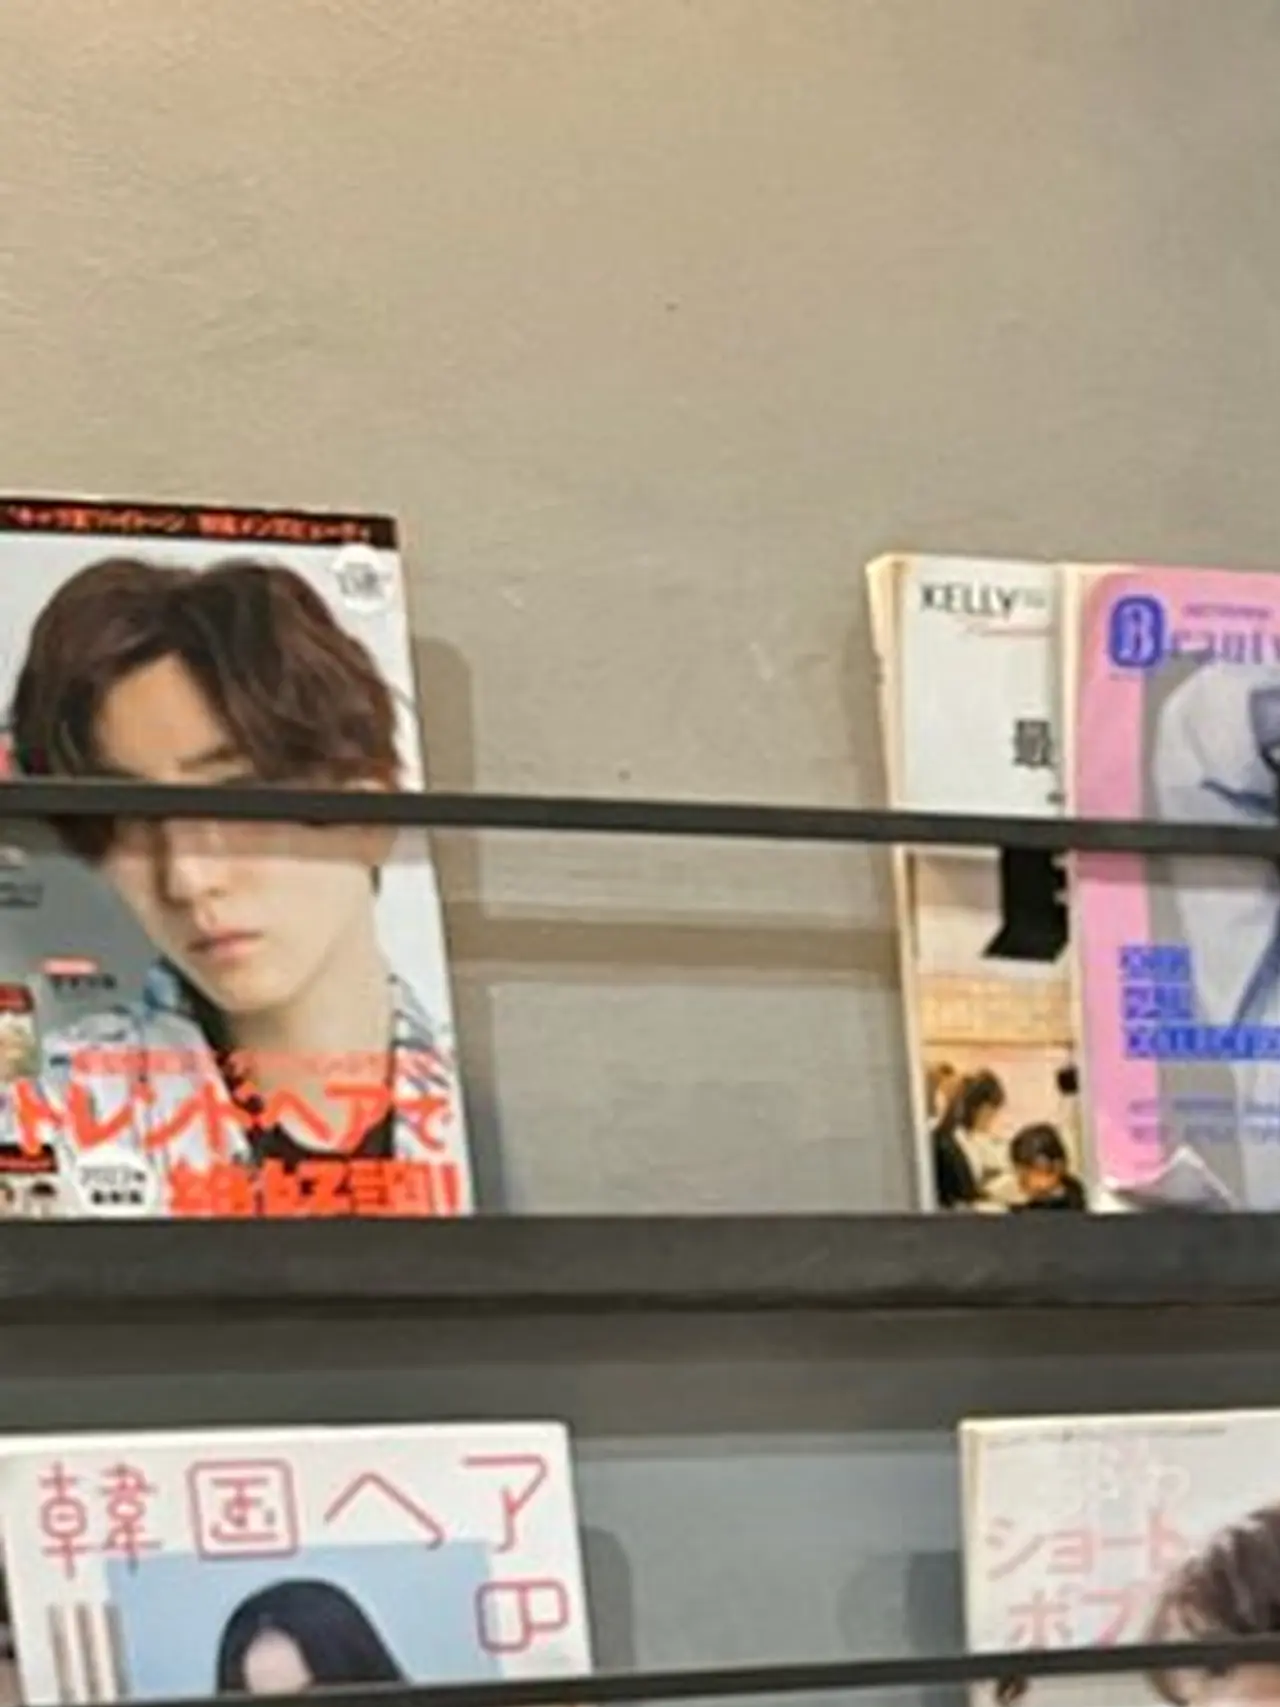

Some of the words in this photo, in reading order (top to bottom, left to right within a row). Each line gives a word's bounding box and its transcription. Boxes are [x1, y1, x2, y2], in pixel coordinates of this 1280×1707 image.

[917, 582, 1020, 622] KELLY
[39, 1453, 550, 1579] 韓国ヘア
